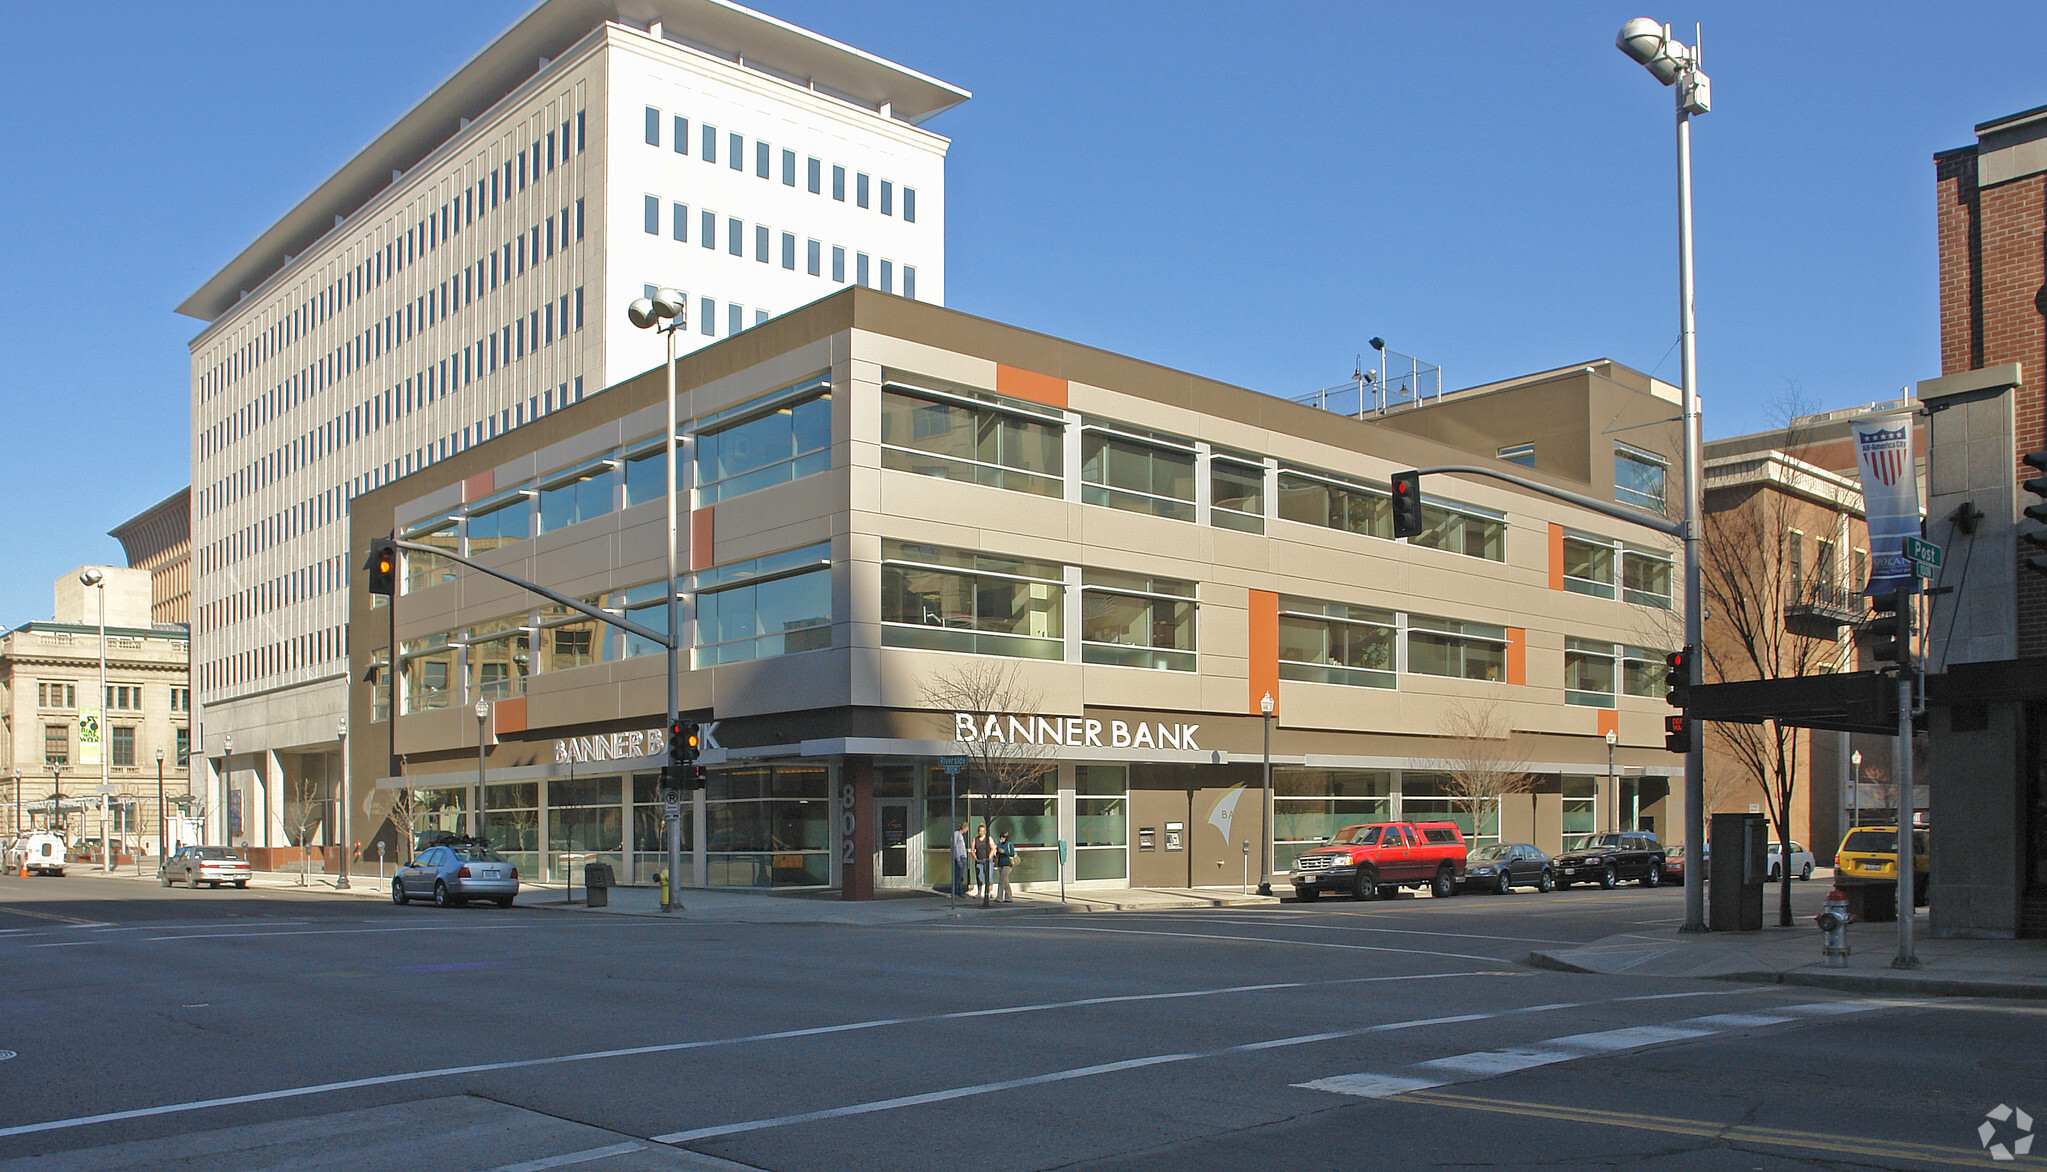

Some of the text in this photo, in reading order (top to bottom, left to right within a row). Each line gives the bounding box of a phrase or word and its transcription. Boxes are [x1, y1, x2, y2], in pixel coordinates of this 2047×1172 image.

[1862, 440, 1907, 452] All-America City
[1915, 541, 1935, 563] Post
[553, 721, 724, 764] BANNER BK
[955, 712, 1200, 751] BANNER BANK
[842, 783, 856, 864] 802
